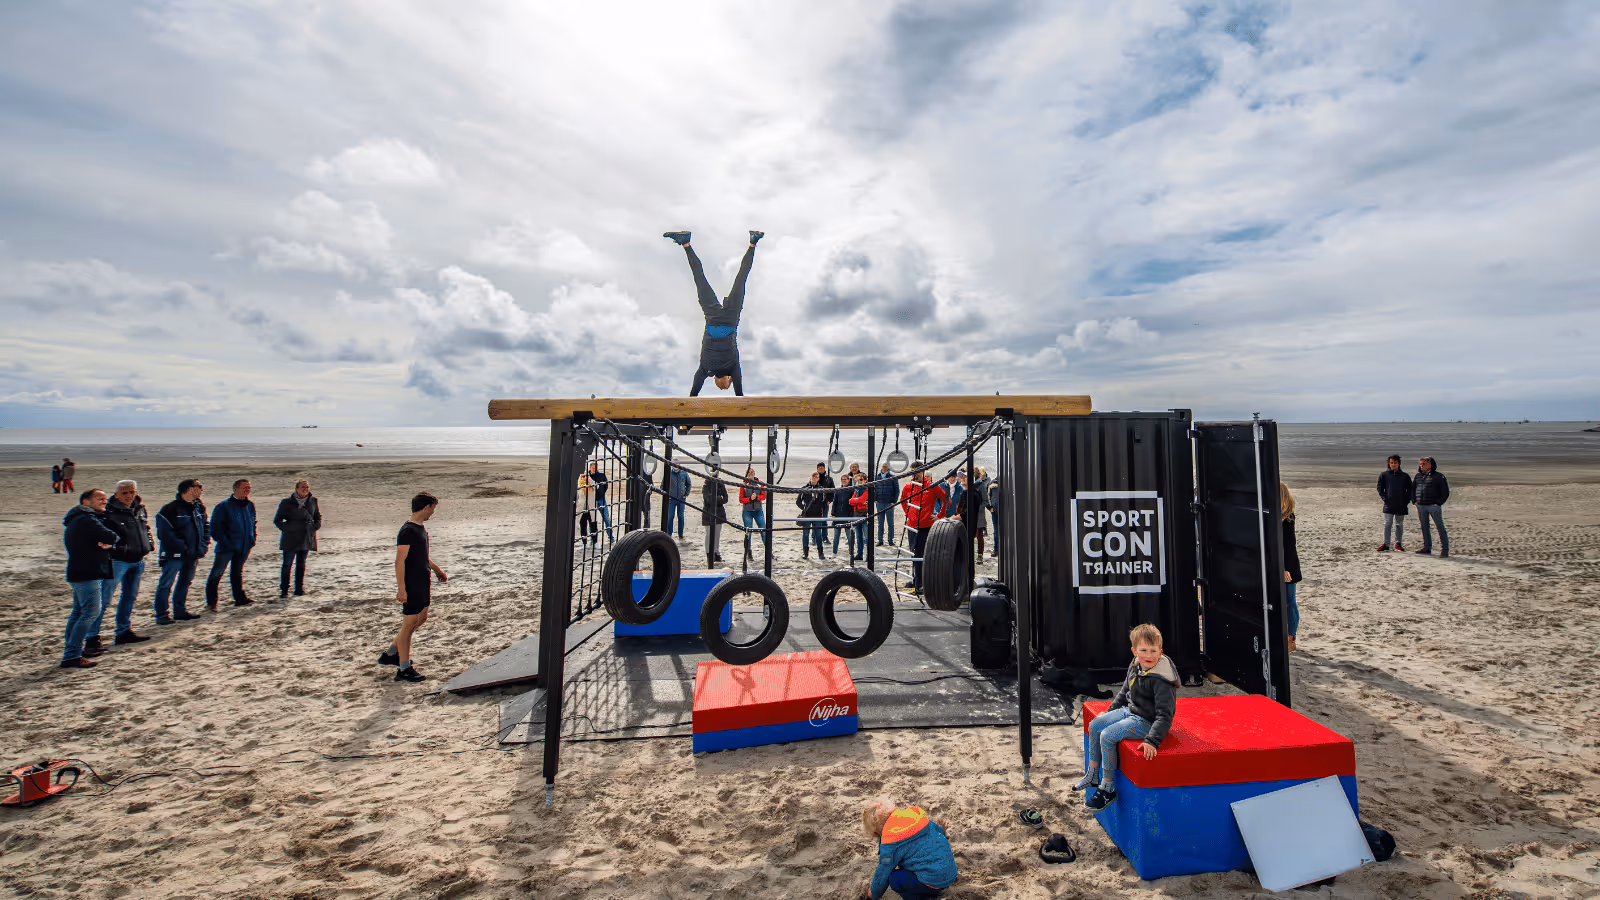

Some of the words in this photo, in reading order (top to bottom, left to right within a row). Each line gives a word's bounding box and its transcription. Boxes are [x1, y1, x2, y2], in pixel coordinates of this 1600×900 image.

[1083, 510, 1154, 527] SPORT
[1082, 531, 1152, 557] CON
[811, 704, 849, 721] Nijha
